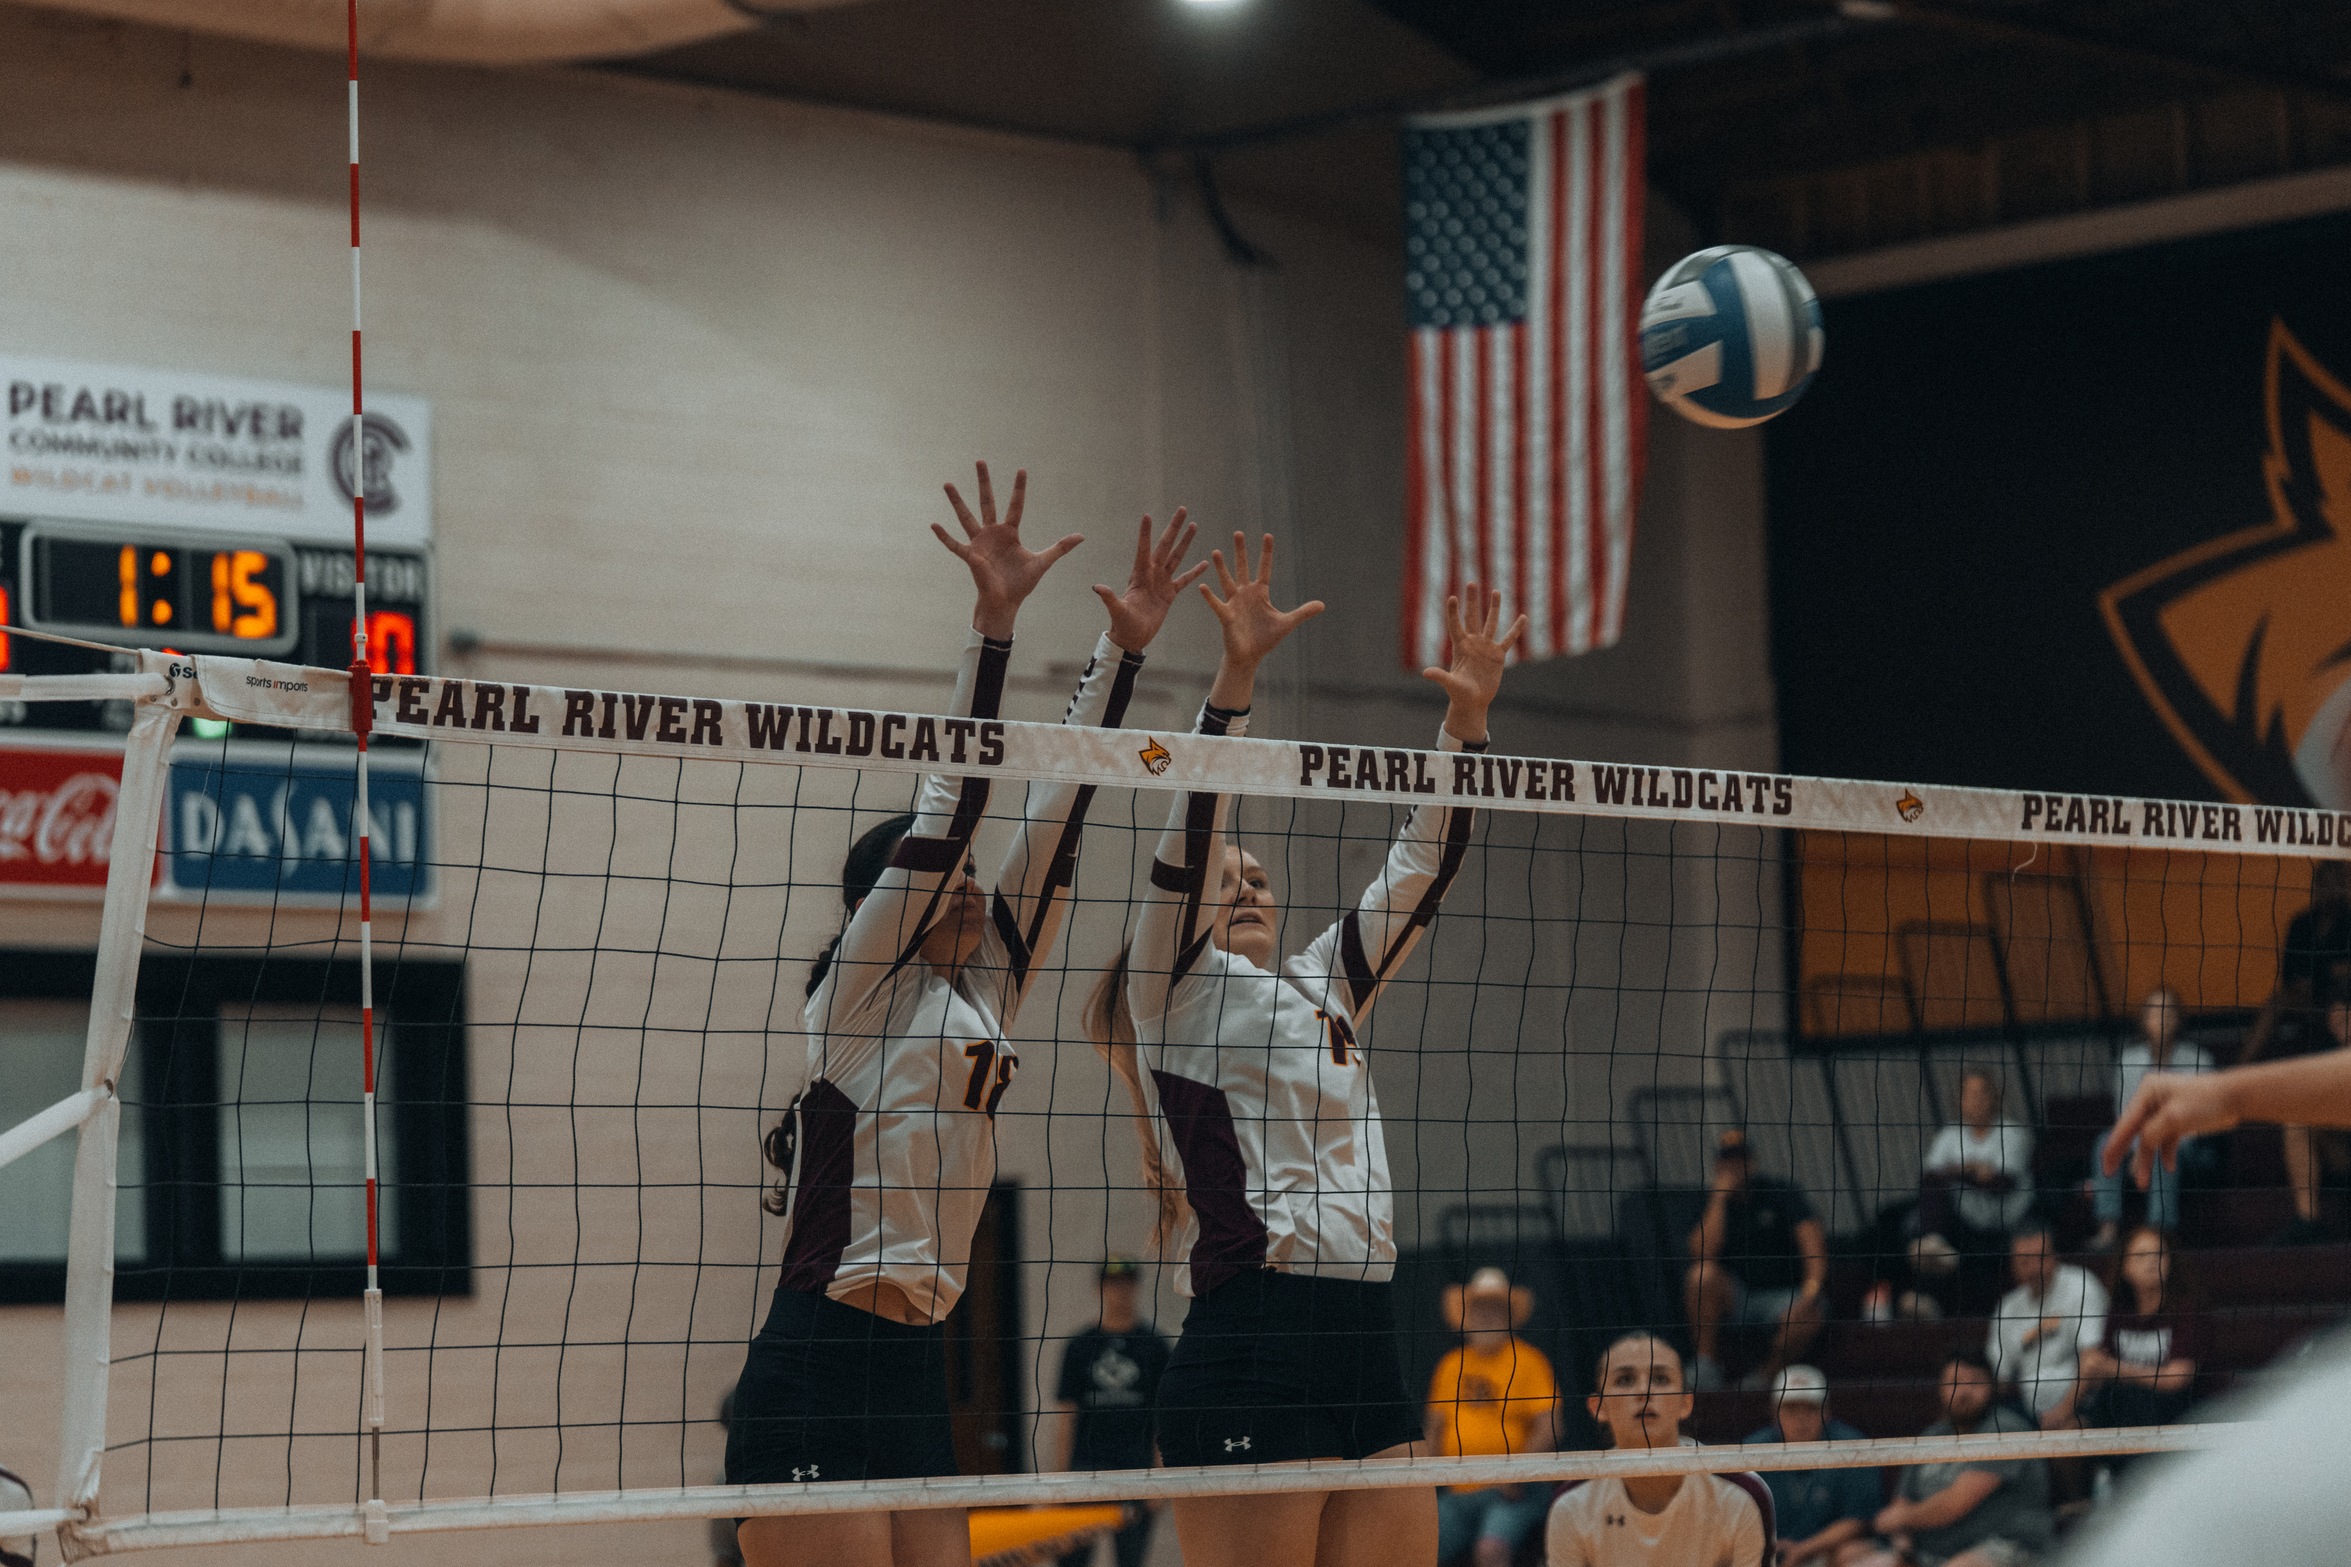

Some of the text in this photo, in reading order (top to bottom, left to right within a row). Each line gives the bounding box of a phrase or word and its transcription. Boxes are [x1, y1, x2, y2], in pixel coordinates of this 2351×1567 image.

[8, 380, 304, 441] PEARL RIVER
[9, 429, 303, 475] COMMUNITY COLLEGE
[118, 543, 277, 640] 1:15
[246, 675, 308, 692] sports imports
[372, 676, 1005, 766] PEARL RIVER WILDCATS
[1300, 745, 1793, 816] PEARL RIVER WILDCATS
[182, 780, 418, 880] DASANI
[2021, 793, 2132, 836] PEARL
[2143, 801, 2243, 843] RIVER
